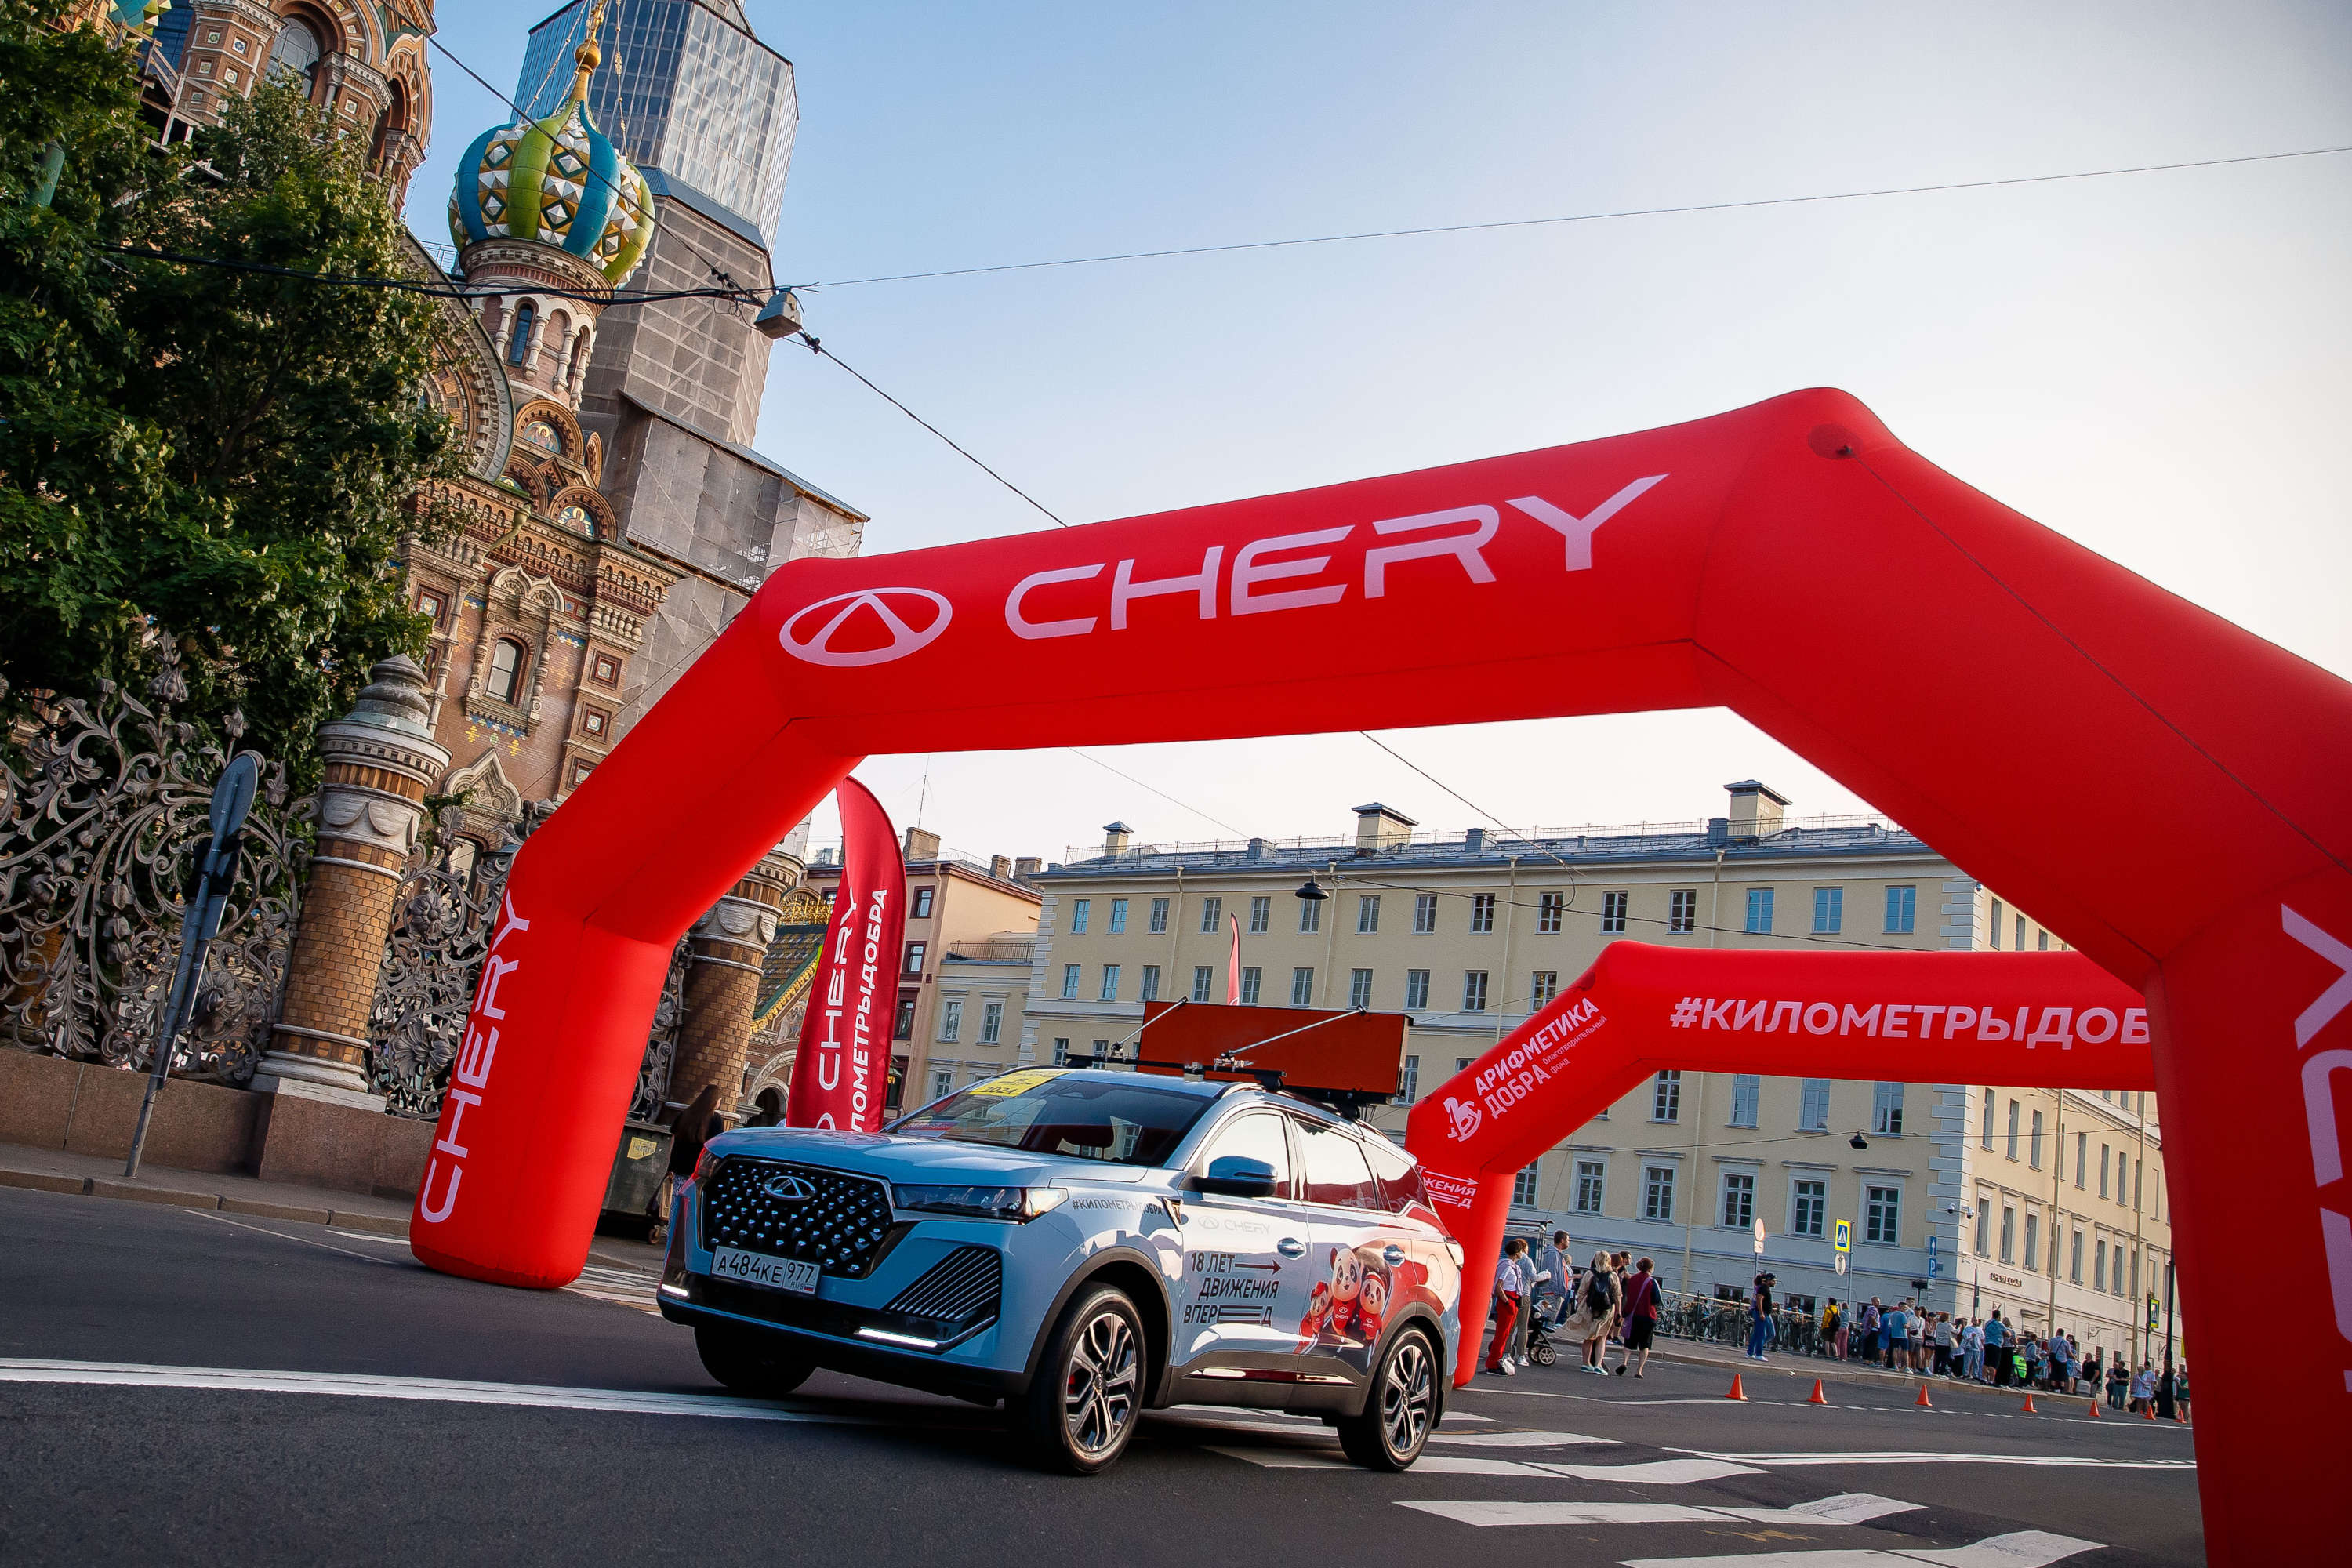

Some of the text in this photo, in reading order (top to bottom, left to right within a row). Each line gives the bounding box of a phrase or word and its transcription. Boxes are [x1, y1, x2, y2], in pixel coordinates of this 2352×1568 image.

[1004, 472, 1671, 641] CHERY
[818, 886, 857, 1091] CHERY
[851, 888, 887, 1132] ЛОМЕТРЫДОБРА
[1475, 997, 1599, 1096] АРИФМЕТИКА
[1541, 1014, 1608, 1065] благотворительный
[1669, 996, 2151, 1051] #КИЛОМЕТРЫДОБ
[420, 887, 531, 1224] CHERY
[1549, 1058, 1572, 1074] фонд
[1484, 1063, 1552, 1120] ДОБРА
[1422, 1176, 1477, 1196] ЖЕНИЯ
[1224, 1218, 1271, 1235] CHERY
[787, 1261, 815, 1283] 977
[790, 1281, 804, 1290] RUS
[1191, 1252, 1236, 1273] 18 ЛЕТ
[1197, 1277, 1279, 1301] ДВИЖЕНИЯ
